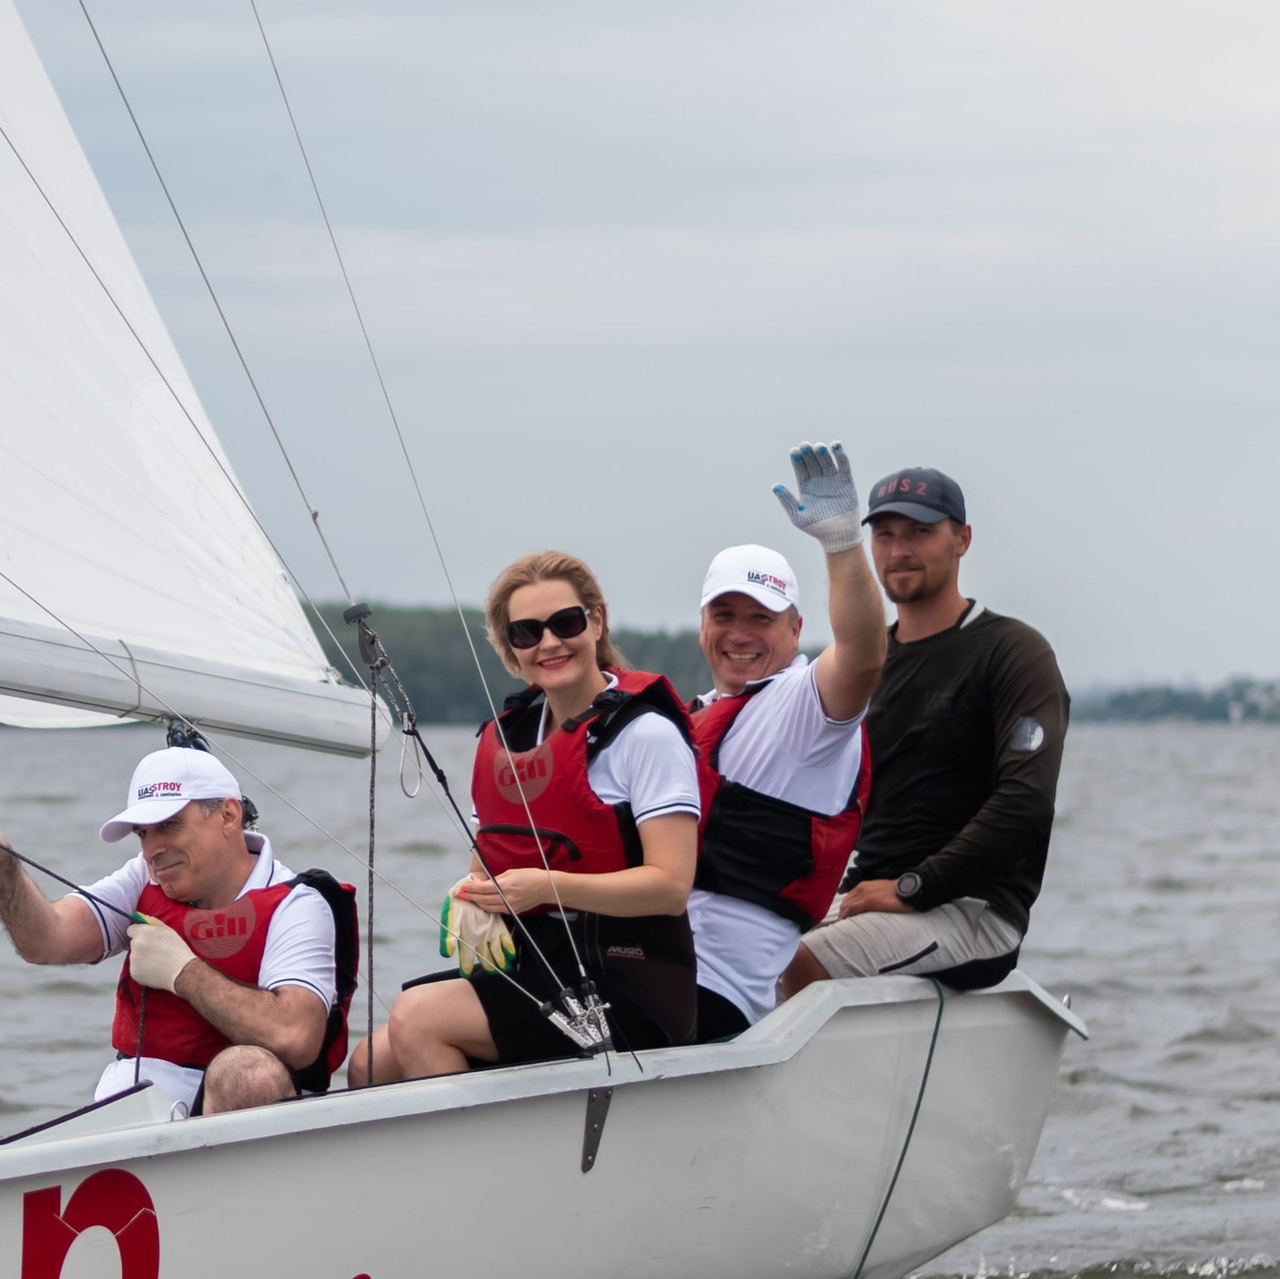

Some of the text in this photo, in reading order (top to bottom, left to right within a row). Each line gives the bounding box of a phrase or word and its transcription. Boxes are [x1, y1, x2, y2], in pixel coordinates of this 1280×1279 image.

[877, 478, 927, 499] RUS 2
[498, 758, 547, 787] Gill
[190, 913, 247, 940] Gill
